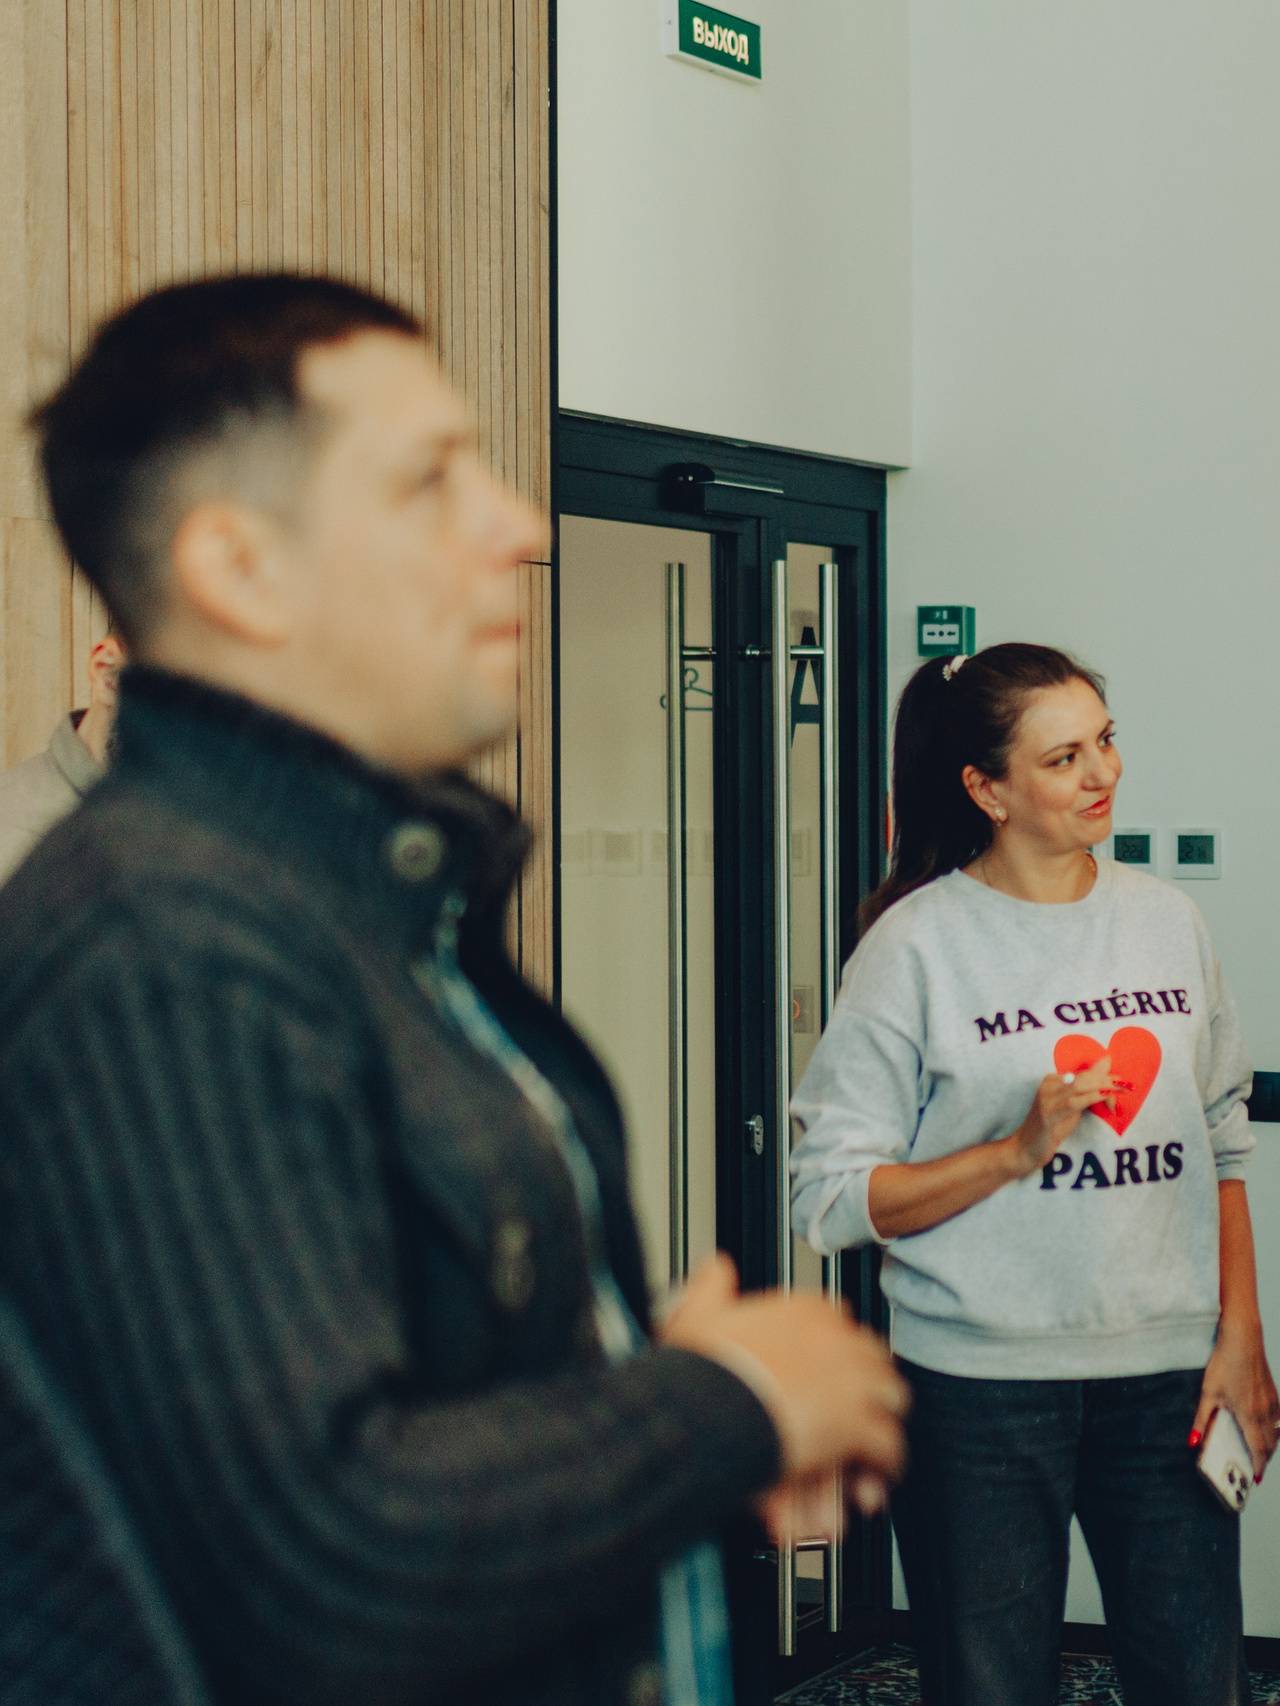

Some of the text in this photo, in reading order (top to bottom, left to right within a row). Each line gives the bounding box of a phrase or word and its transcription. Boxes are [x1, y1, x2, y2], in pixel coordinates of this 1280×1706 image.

[693, 16, 749, 65] ВЫХОД
[974, 988, 1192, 1043] MA CHÉRIE
[1039, 1142, 1184, 1190] PARIS
